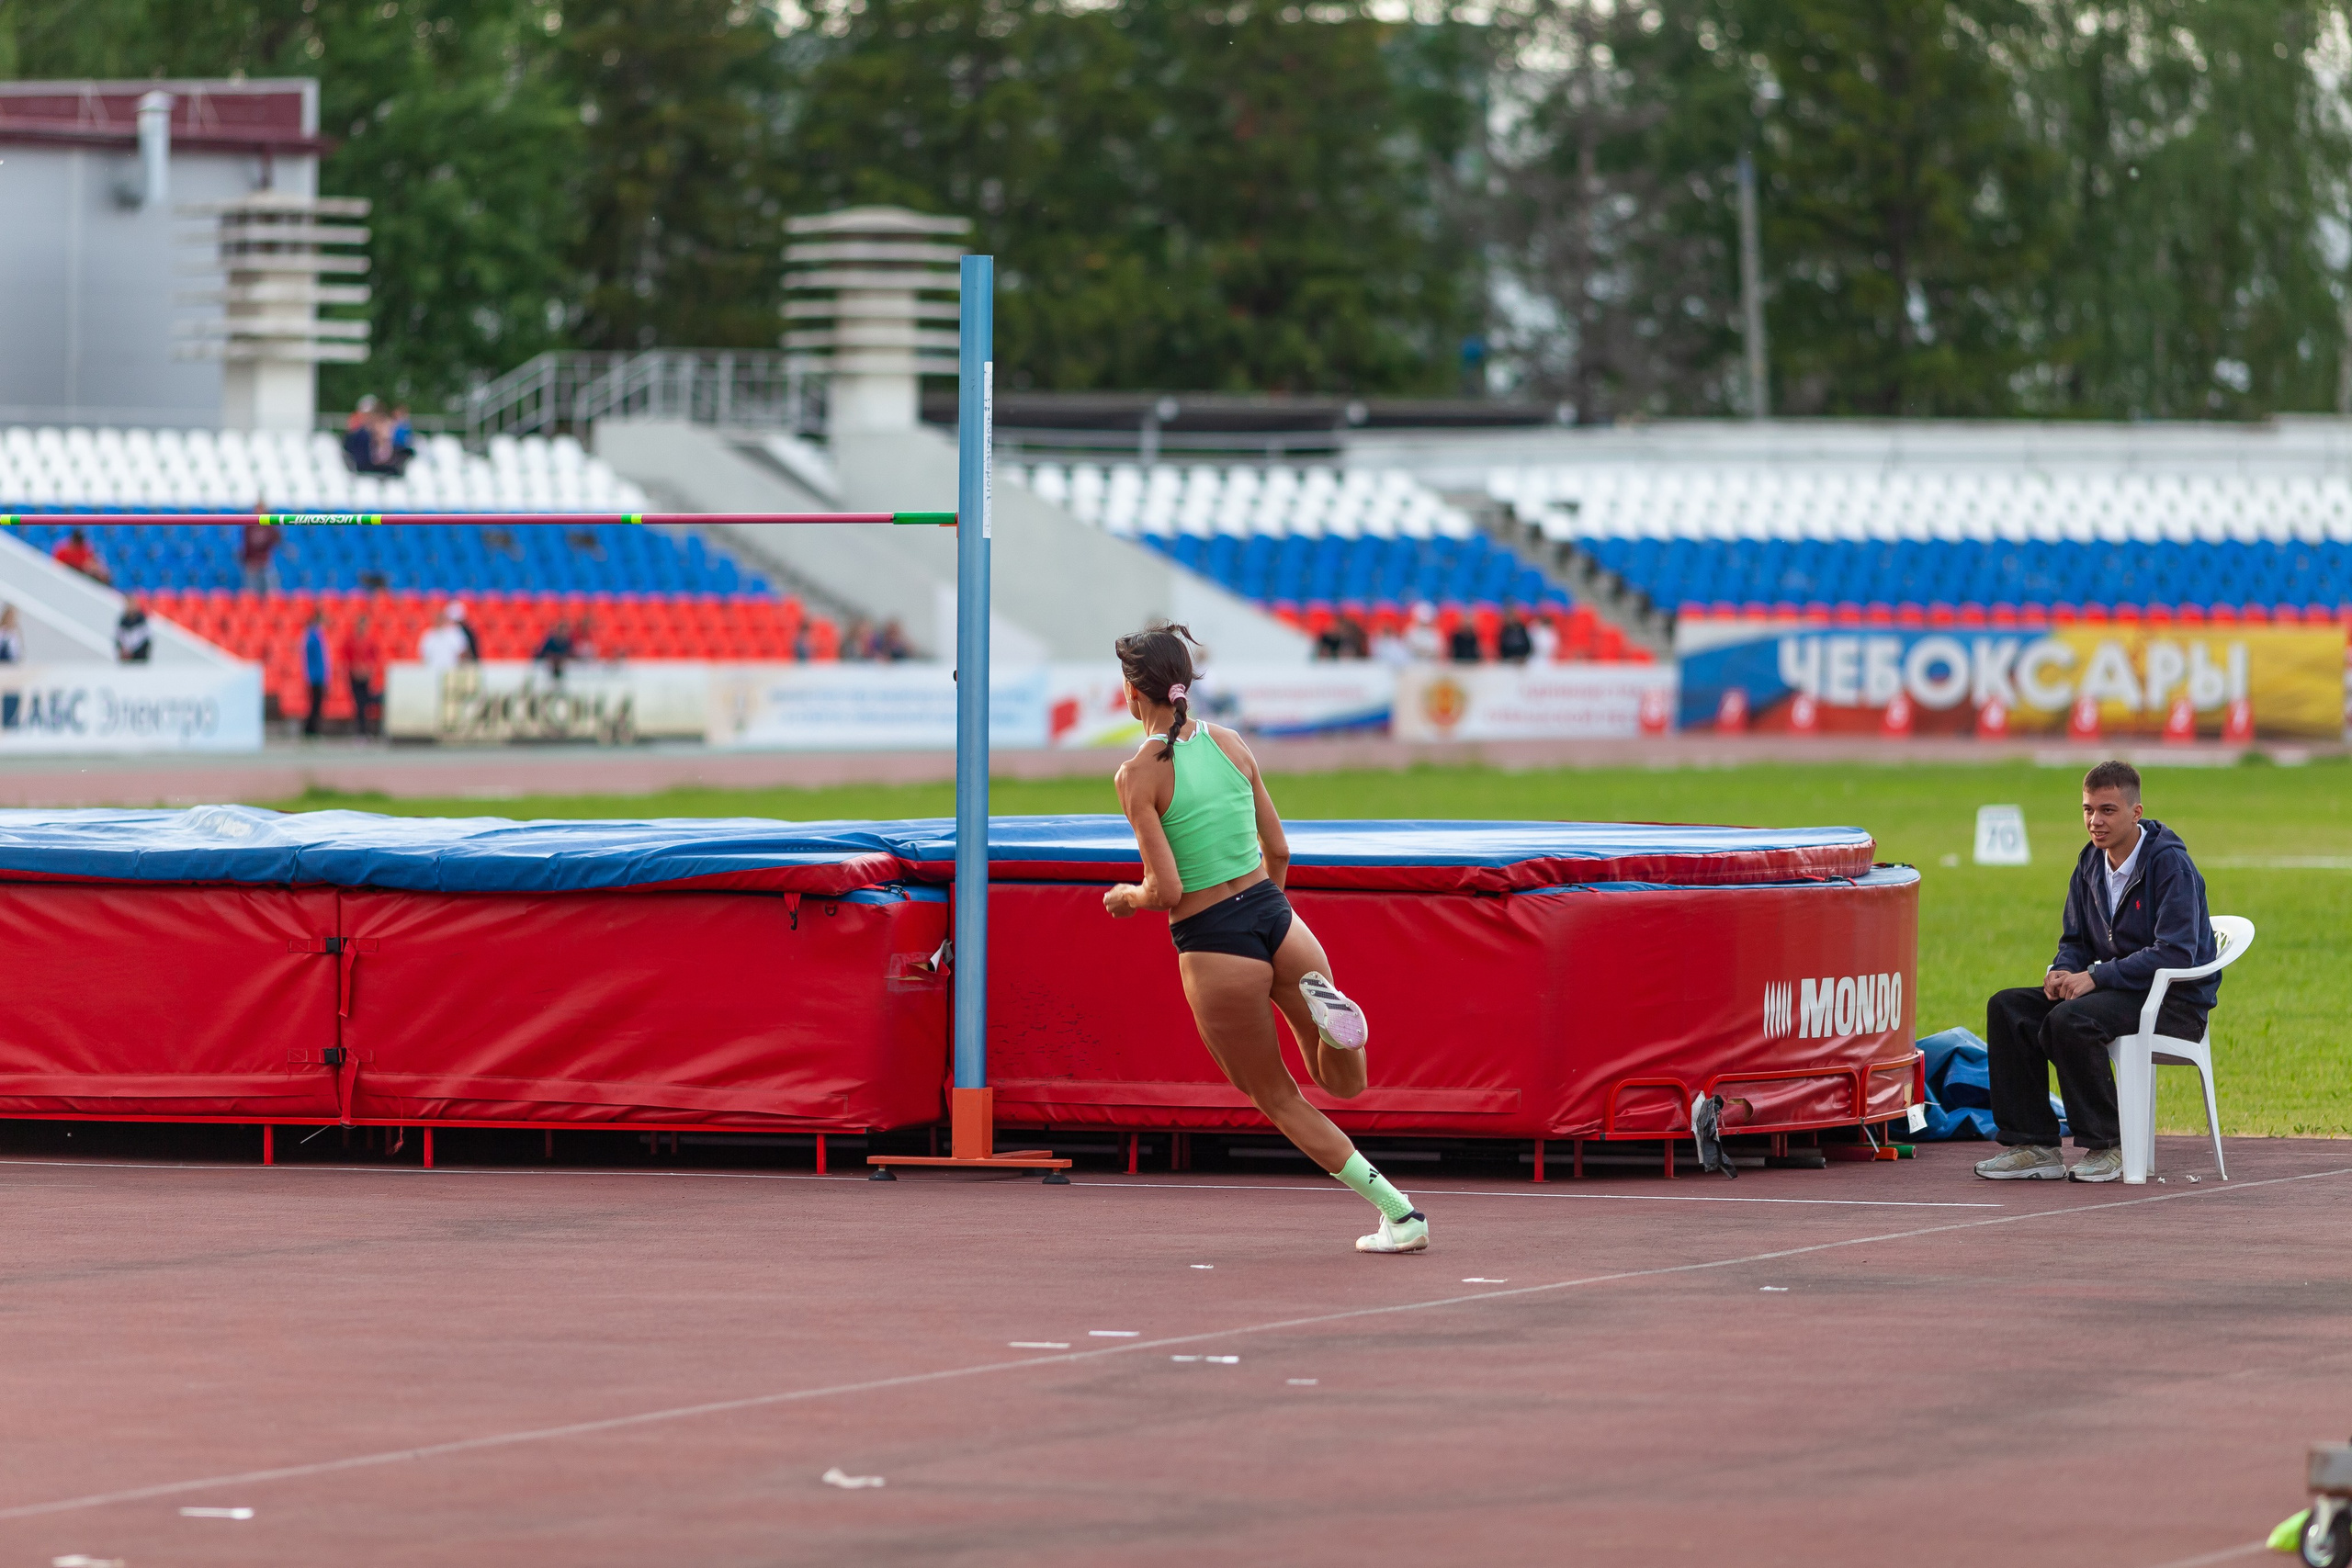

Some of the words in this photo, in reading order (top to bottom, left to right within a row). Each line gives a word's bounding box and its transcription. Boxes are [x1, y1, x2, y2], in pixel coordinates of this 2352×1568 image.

[1777, 636, 2249, 711] ЧЕБОКСАРЫ
[26, 687, 86, 733] АБС
[1985, 826, 2020, 853] 70
[1799, 971, 1902, 1039] MONDO
